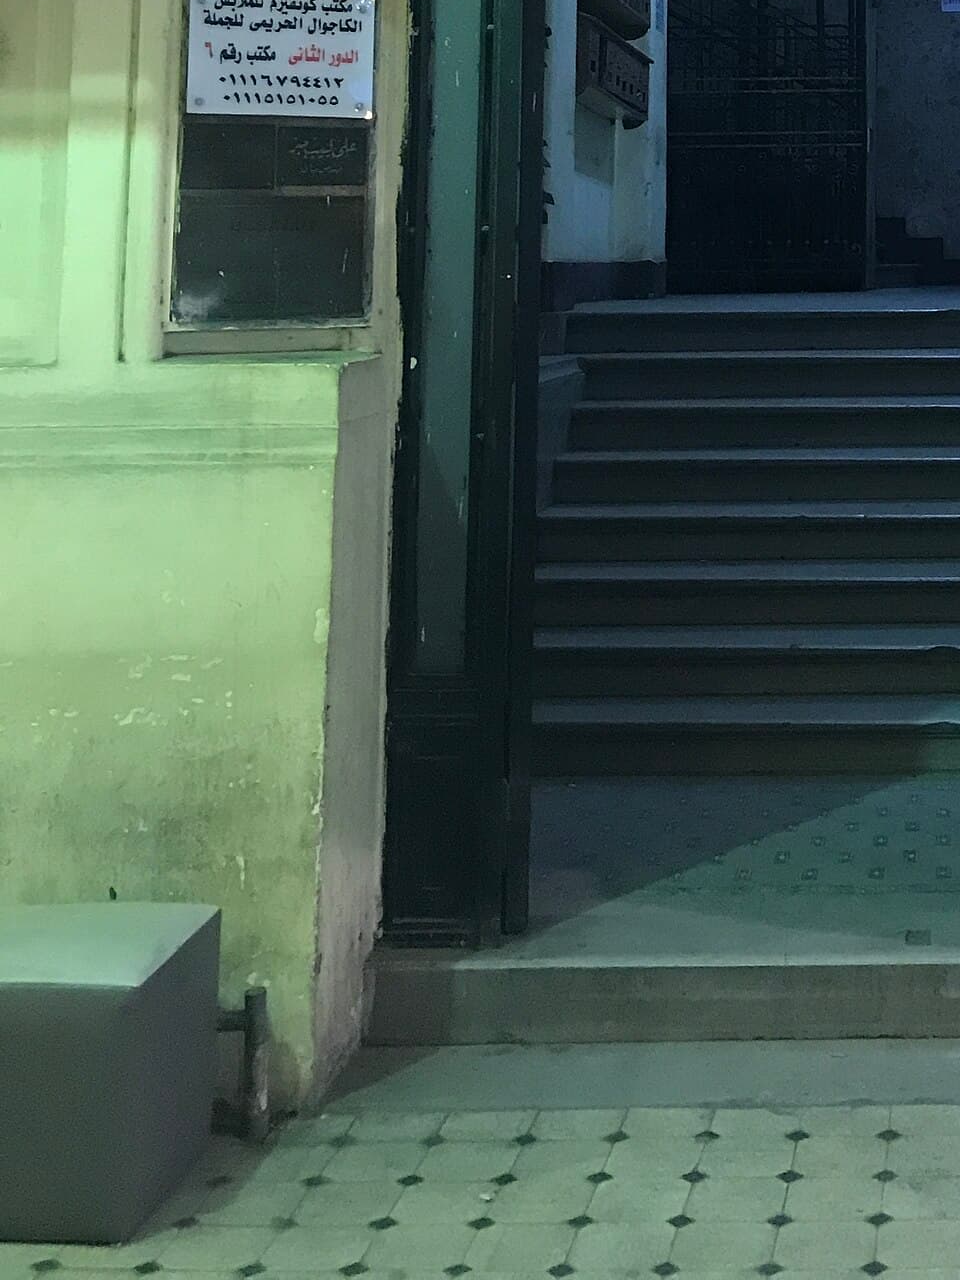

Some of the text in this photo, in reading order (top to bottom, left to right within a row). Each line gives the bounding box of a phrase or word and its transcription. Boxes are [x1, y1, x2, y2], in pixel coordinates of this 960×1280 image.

[322, 0, 353, 16] مكتب
[203, 9, 362, 35] الكاجوال الحريمى للجملة
[219, 43, 242, 65] رقم
[246, 45, 276, 66] مكتب
[288, 44, 325, 66] الثانى
[328, 49, 358, 67] الدور
